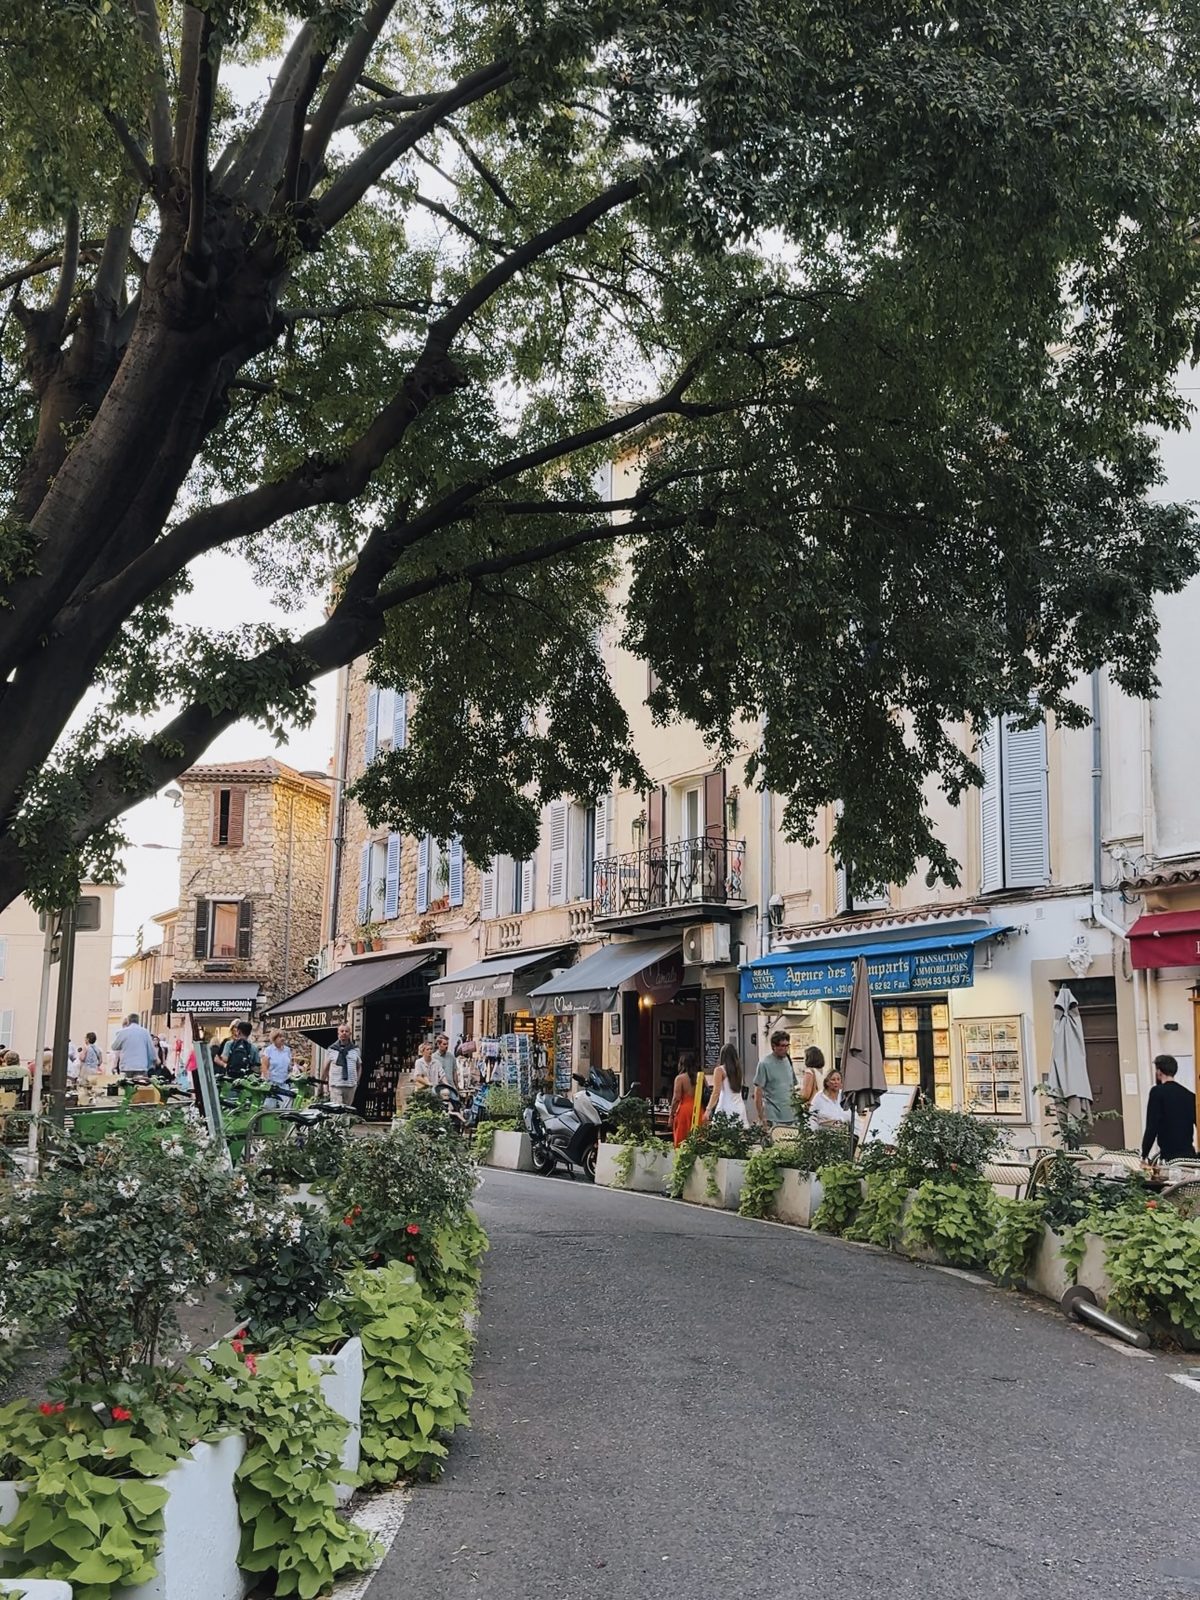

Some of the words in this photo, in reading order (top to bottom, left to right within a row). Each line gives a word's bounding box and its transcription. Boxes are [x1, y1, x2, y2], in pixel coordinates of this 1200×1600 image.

[915, 951, 968, 965] TRANSACTIONS
[784, 966, 824, 987] Agence
[827, 965, 847, 979] des
[851, 958, 909, 984] Rmparts
[280, 1012, 327, 1029] L'EMPEREUR
